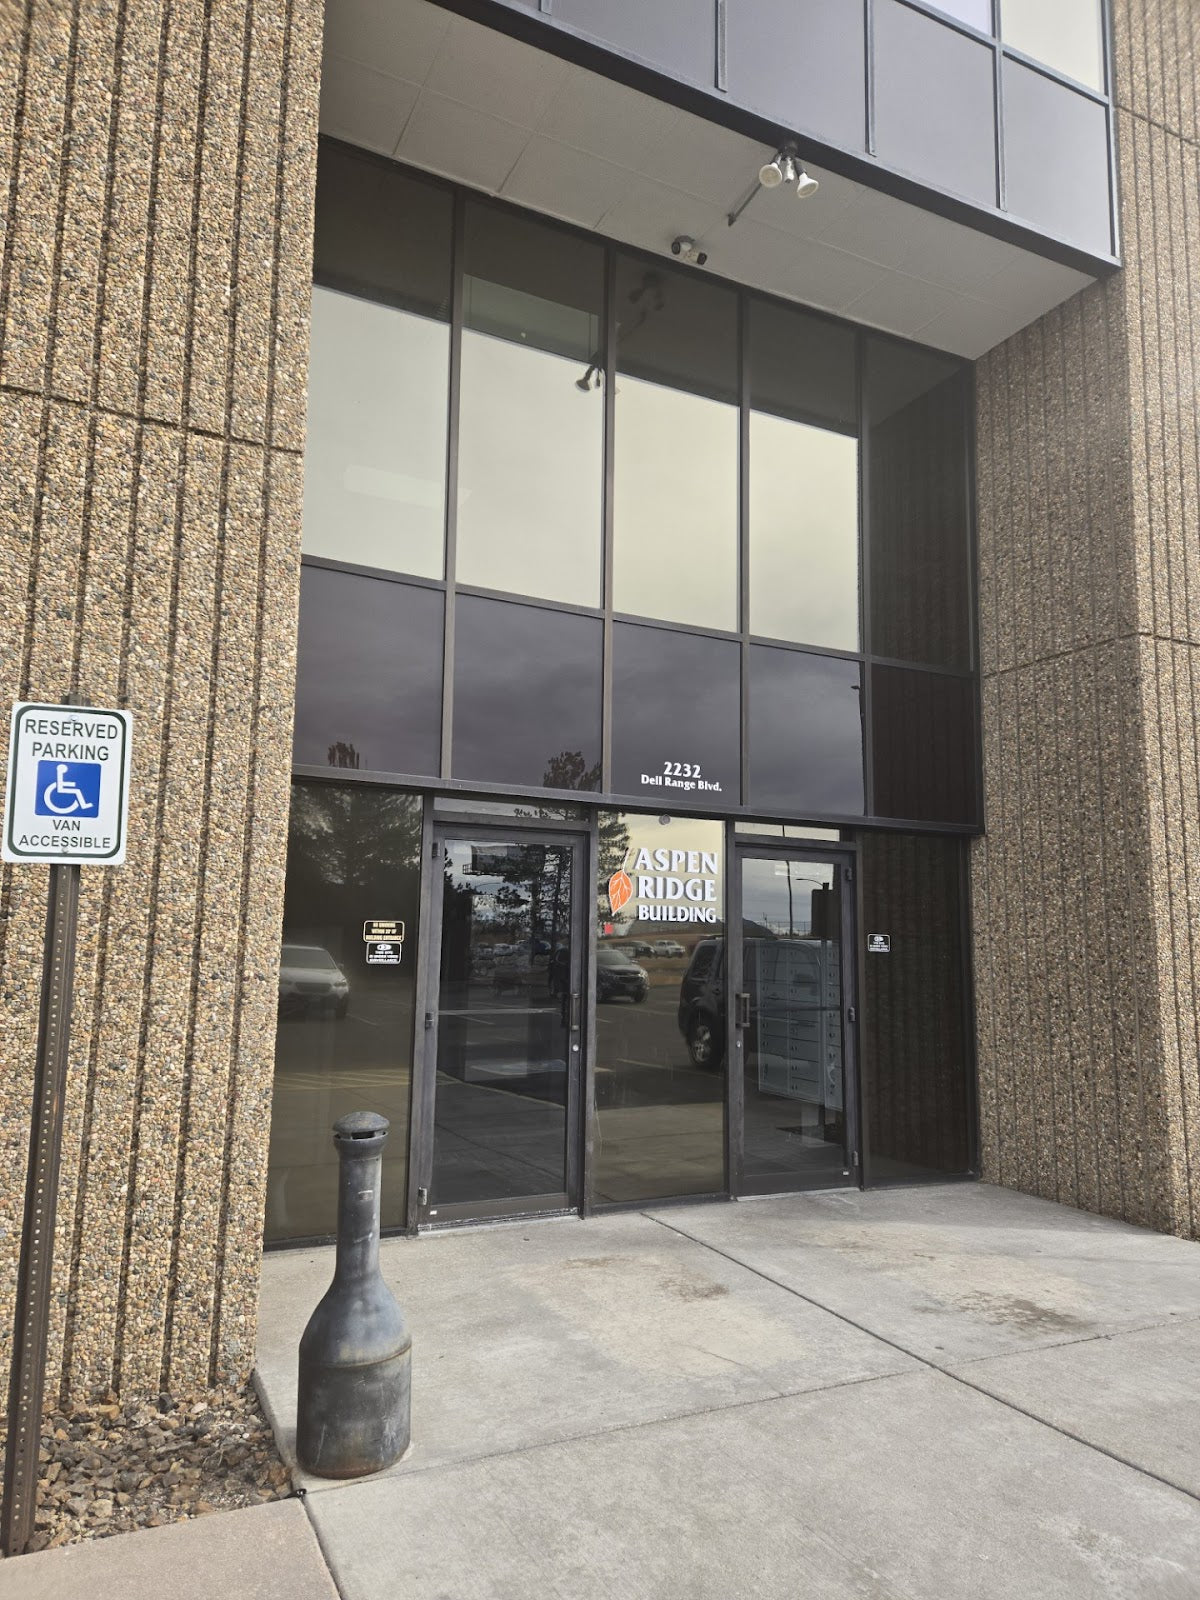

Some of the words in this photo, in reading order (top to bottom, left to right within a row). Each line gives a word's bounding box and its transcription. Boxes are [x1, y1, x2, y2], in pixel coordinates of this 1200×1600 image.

[25, 719, 118, 739] RESERVED
[32, 742, 109, 761] PARKING
[663, 761, 702, 778] 2232
[641, 774, 662, 785] Dell
[664, 776, 695, 790] Range
[697, 780, 722, 791] Blvd.
[53, 819, 81, 831] VAN
[19, 835, 111, 849] ACCESSIBLE
[634, 847, 718, 874] ASPEN
[637, 875, 717, 902] RIDGE
[638, 905, 717, 923] BUILDING
